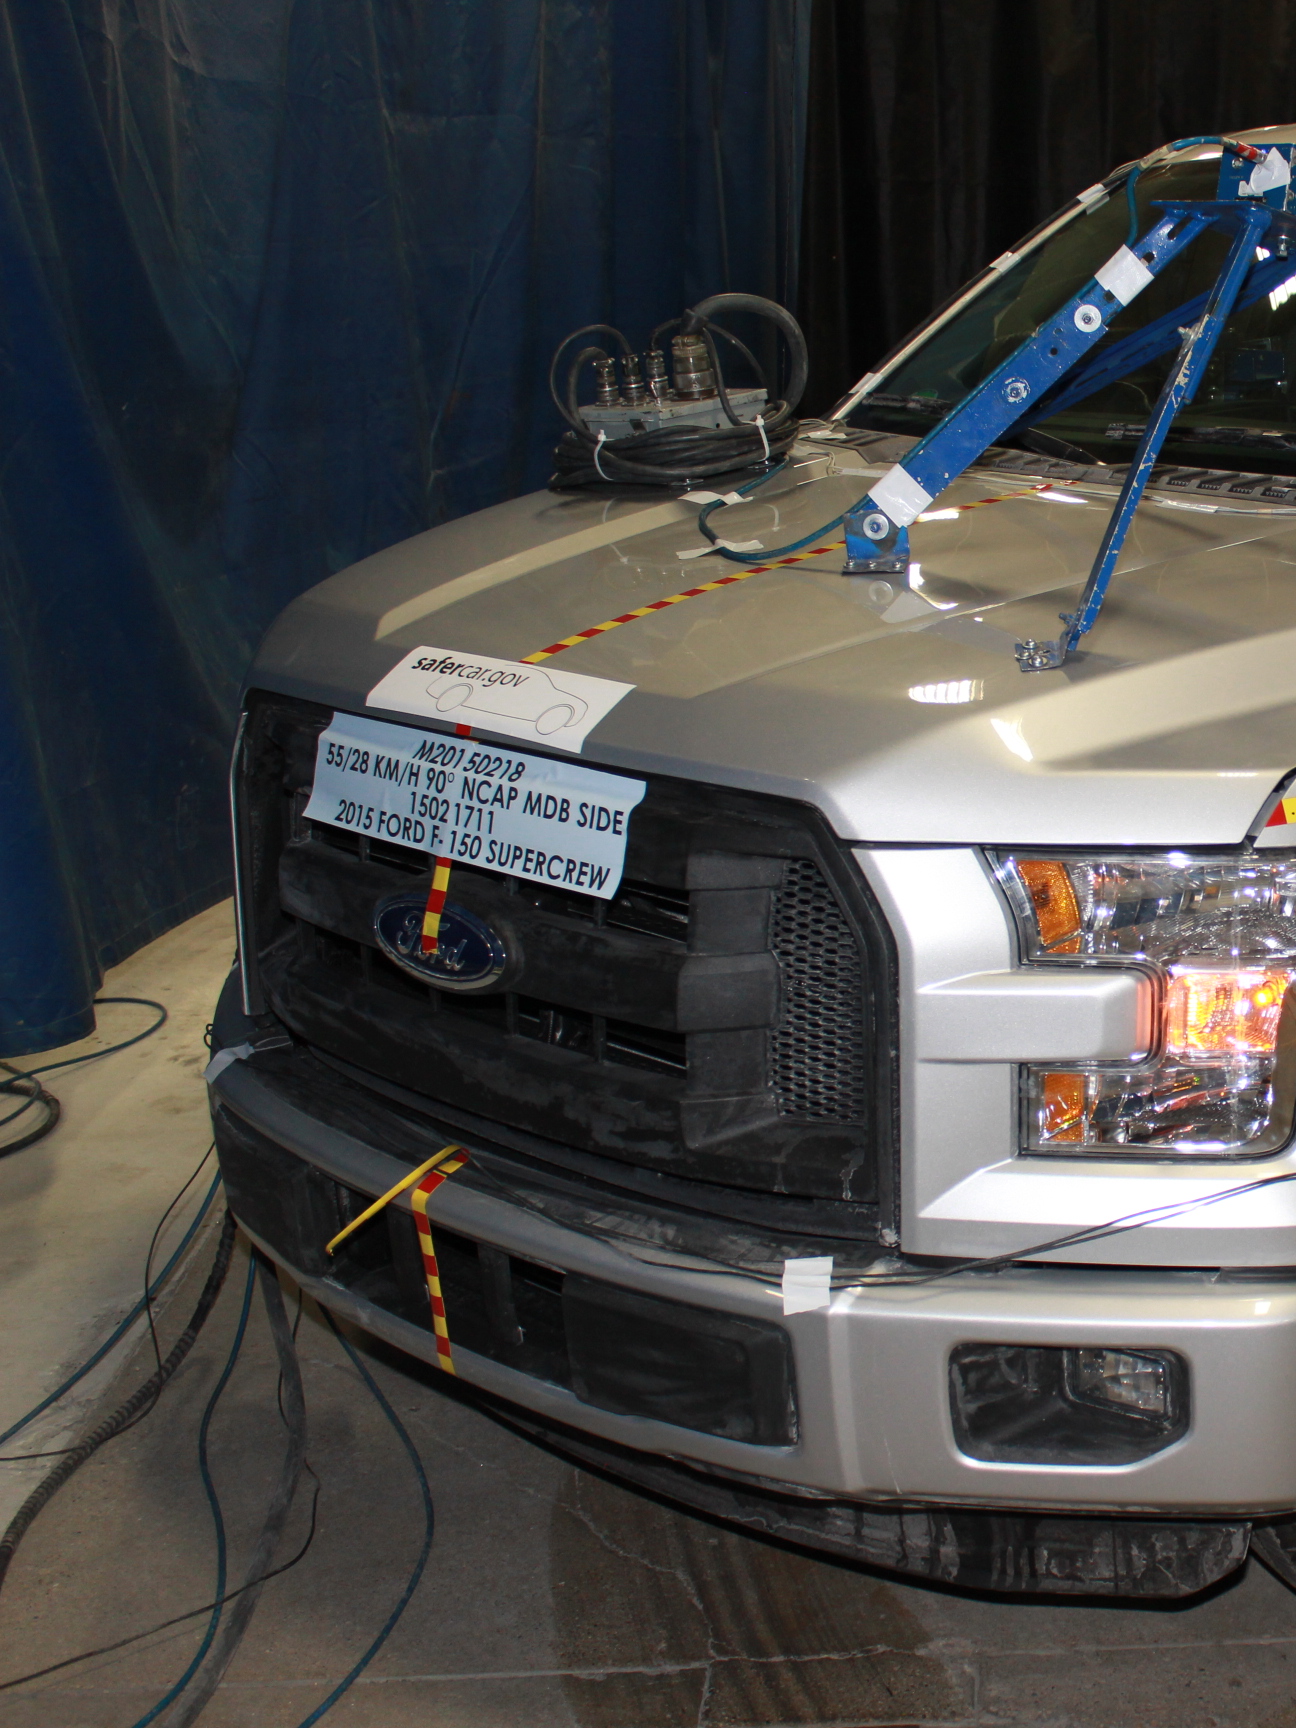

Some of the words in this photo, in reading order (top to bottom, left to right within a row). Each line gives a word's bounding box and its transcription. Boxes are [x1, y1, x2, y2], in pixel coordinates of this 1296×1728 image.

[411, 656, 530, 688] safercar.gov
[326, 743, 370, 775] 55/28
[373, 754, 421, 787] KM/H
[426, 767, 455, 794] 90°
[461, 776, 518, 810] NCAP
[522, 790, 570, 822] MDB
[576, 802, 624, 836] SIDE
[334, 799, 375, 830] 2015
[377, 810, 425, 843] FORD
[486, 839, 611, 890] SUPERCREW
